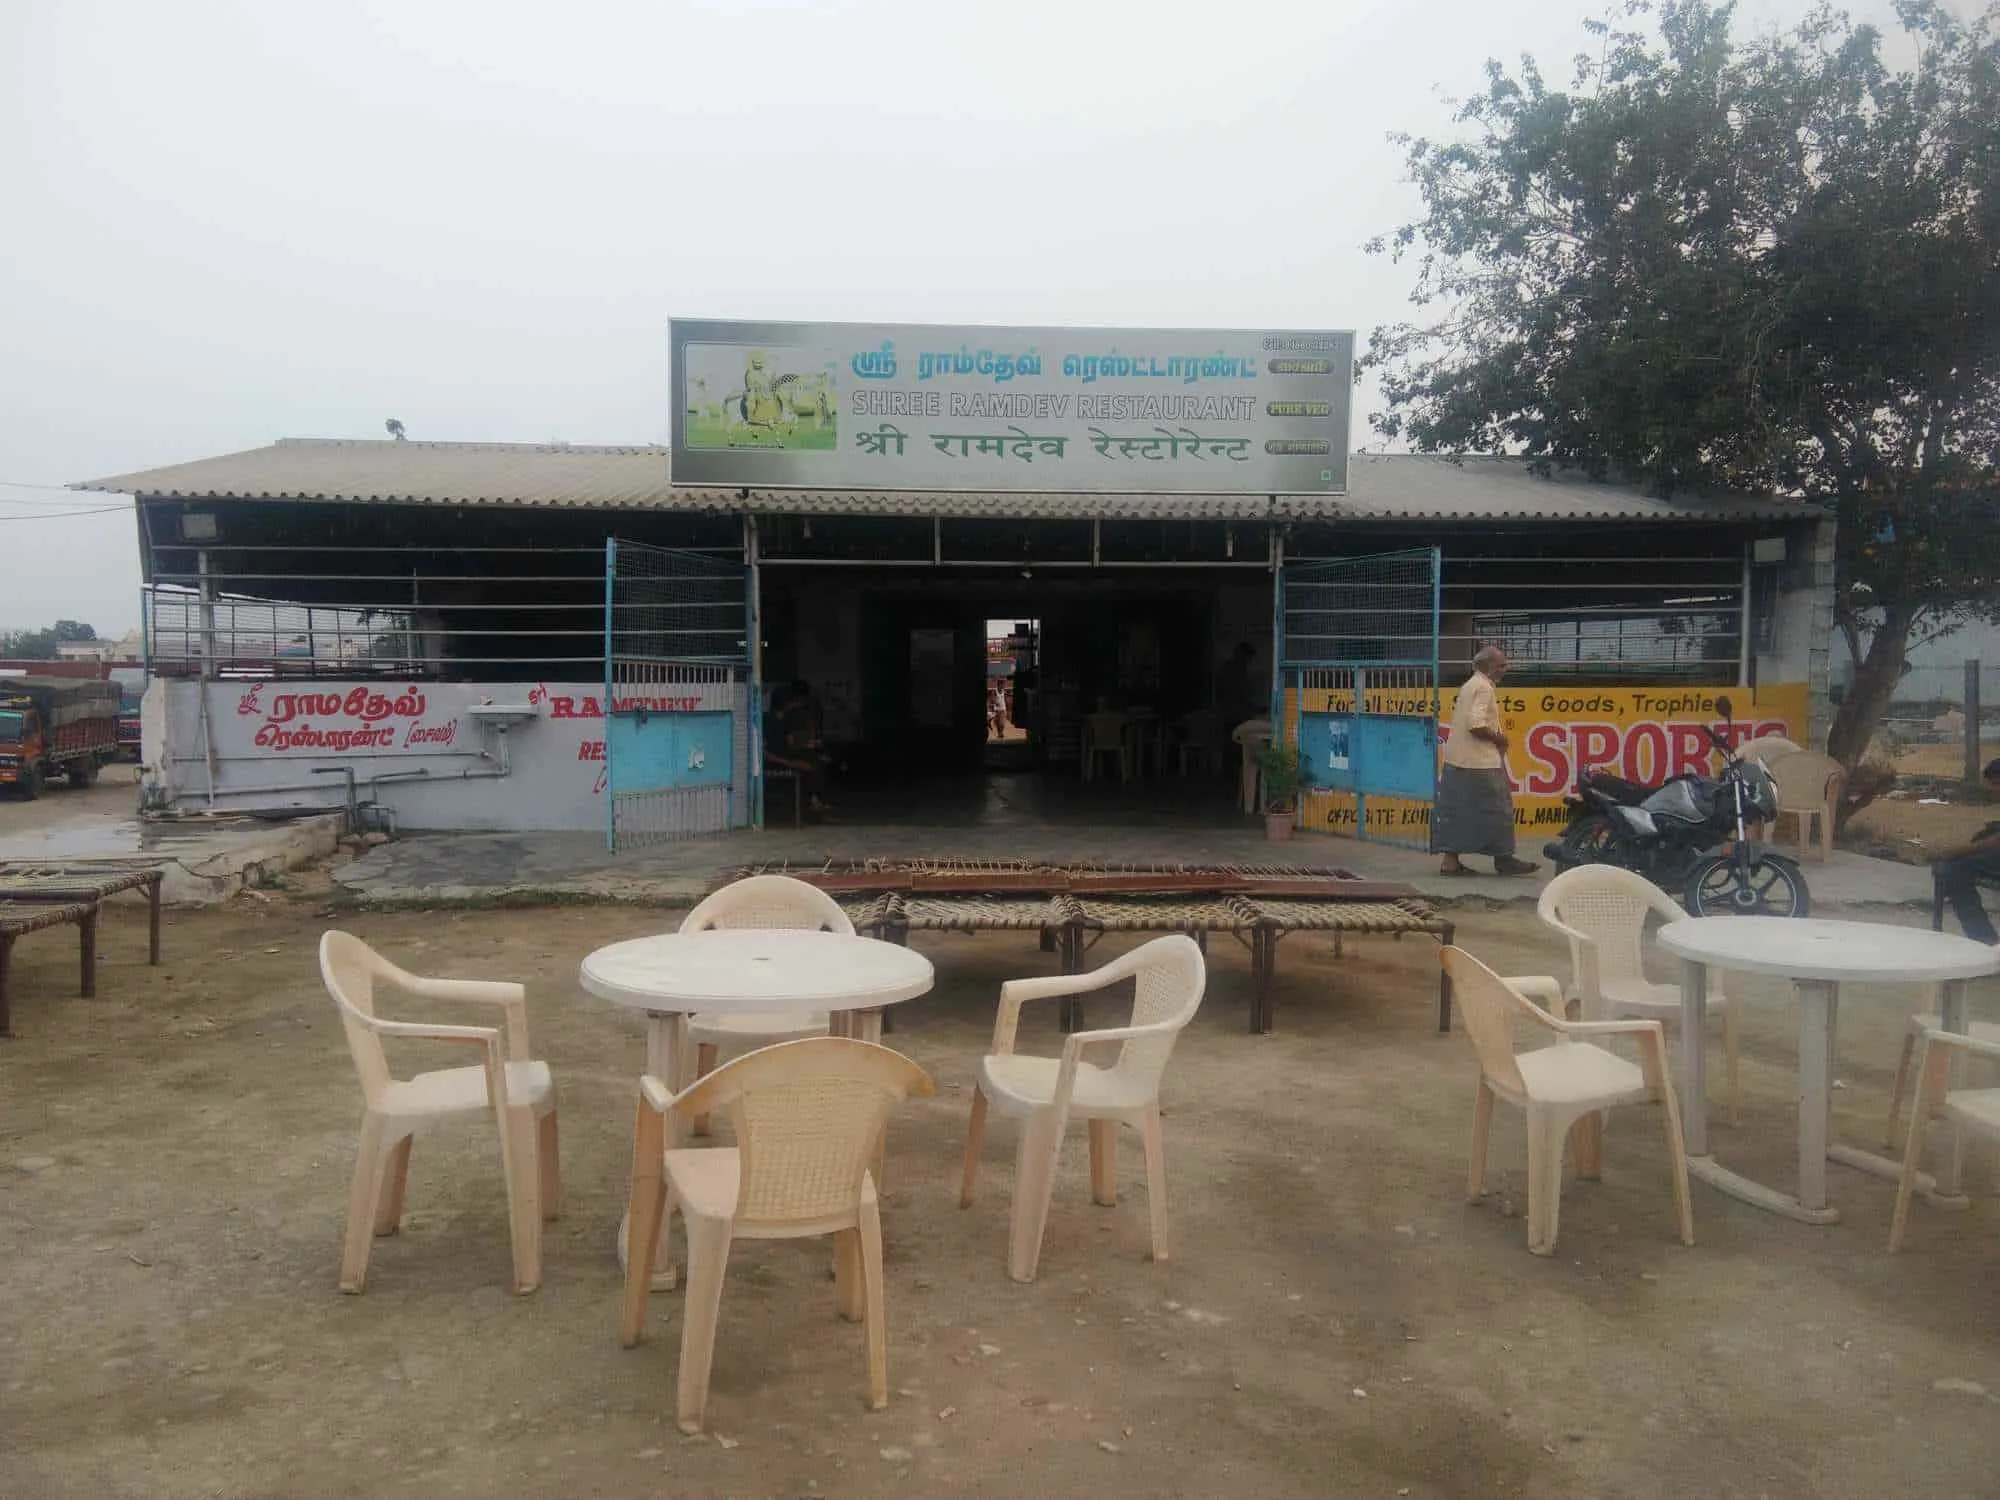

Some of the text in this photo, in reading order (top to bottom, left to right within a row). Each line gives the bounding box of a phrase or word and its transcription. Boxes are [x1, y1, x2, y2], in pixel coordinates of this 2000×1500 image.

[852, 390, 1257, 423] SHREE RAMDEV RESTAURANT
[856, 424, 1252, 463] श्री रामदेव रेस्टोरेन्ट
[1632, 694, 1714, 716] Trophie
